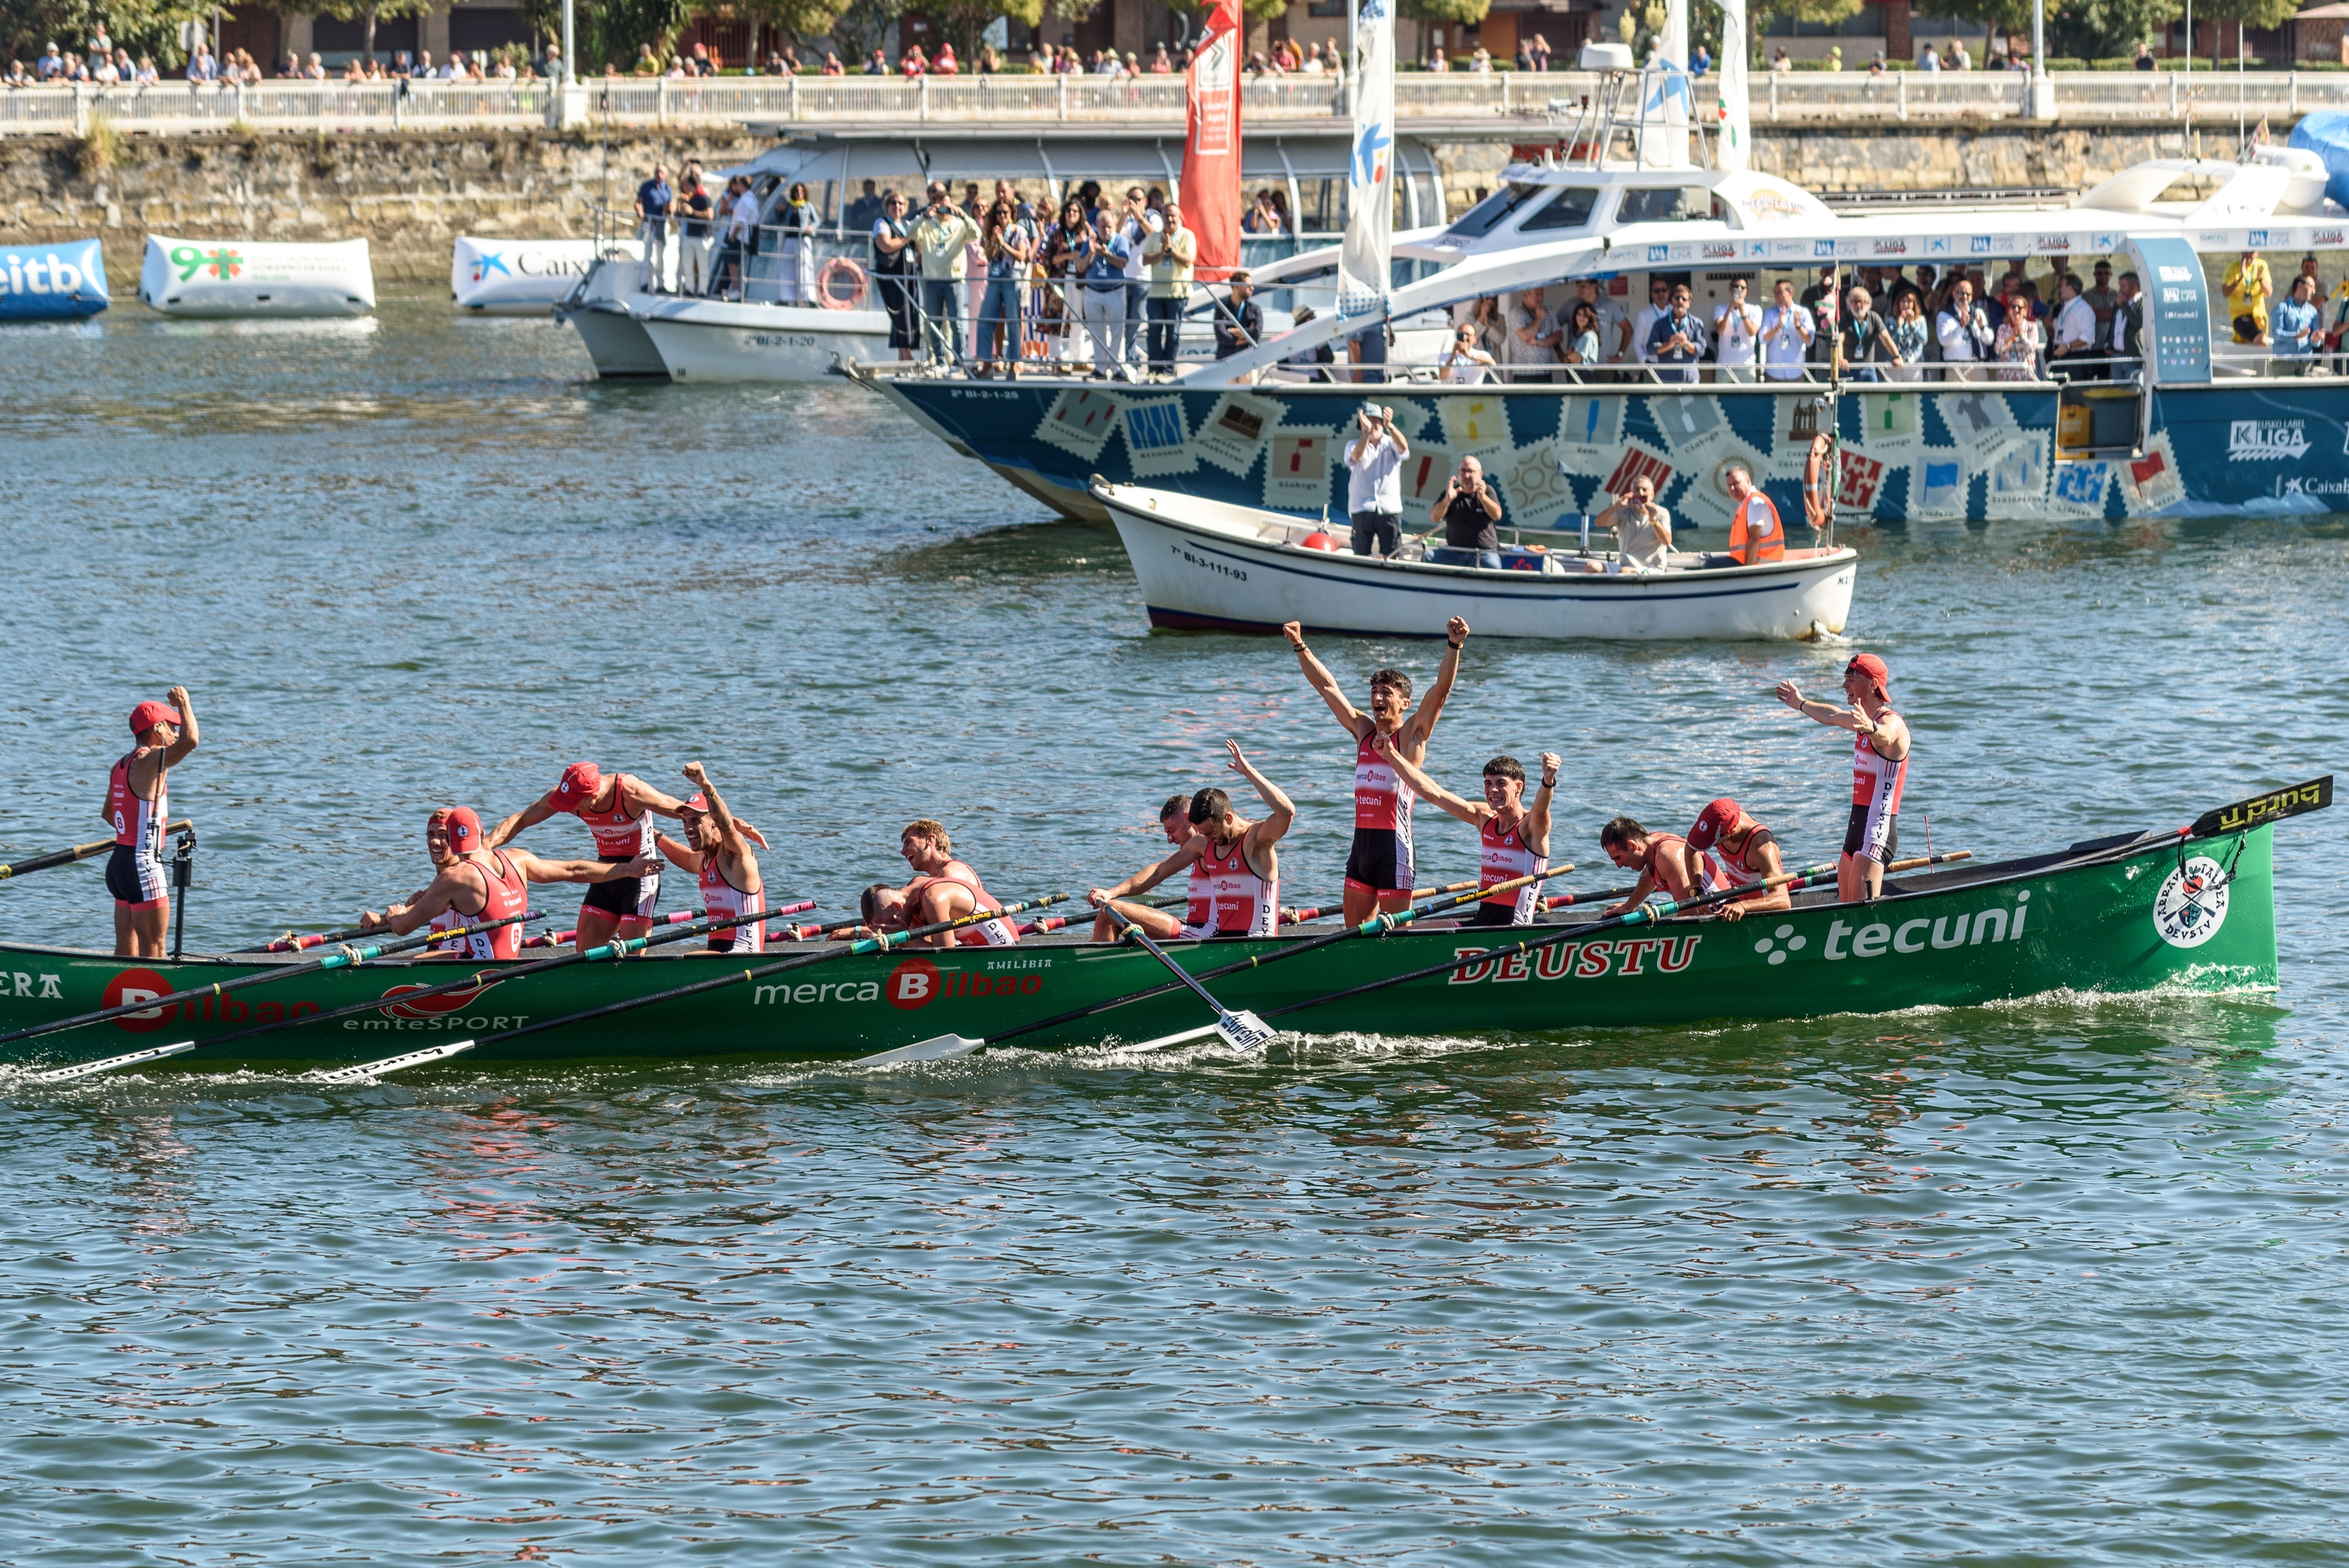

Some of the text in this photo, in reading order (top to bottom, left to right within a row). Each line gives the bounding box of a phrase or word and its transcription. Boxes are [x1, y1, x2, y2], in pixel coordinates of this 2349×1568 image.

[2257, 419, 2282, 429] EUSKO
[2283, 419, 2306, 429] LABEL
[1684, 430, 1720, 454] Ciaboga
[2257, 428, 2305, 446] LIGA
[1778, 460, 1804, 468] Caixa
[1278, 481, 1318, 490] Ziaboga
[1404, 499, 1427, 509] Remo
[1918, 509, 1954, 517] Bandera
[1183, 551, 1247, 582] BI-3-111-93
[1359, 795, 1382, 806] tecuni
[1876, 781, 1893, 839] DEVSTV
[1218, 901, 1239, 910] tecuni
[1824, 889, 2031, 961] tecuni
[2164, 920, 2211, 940] DEVSTV
[1448, 935, 1703, 985] DEUSTU
[343, 1015, 529, 1031] emteSPORT
